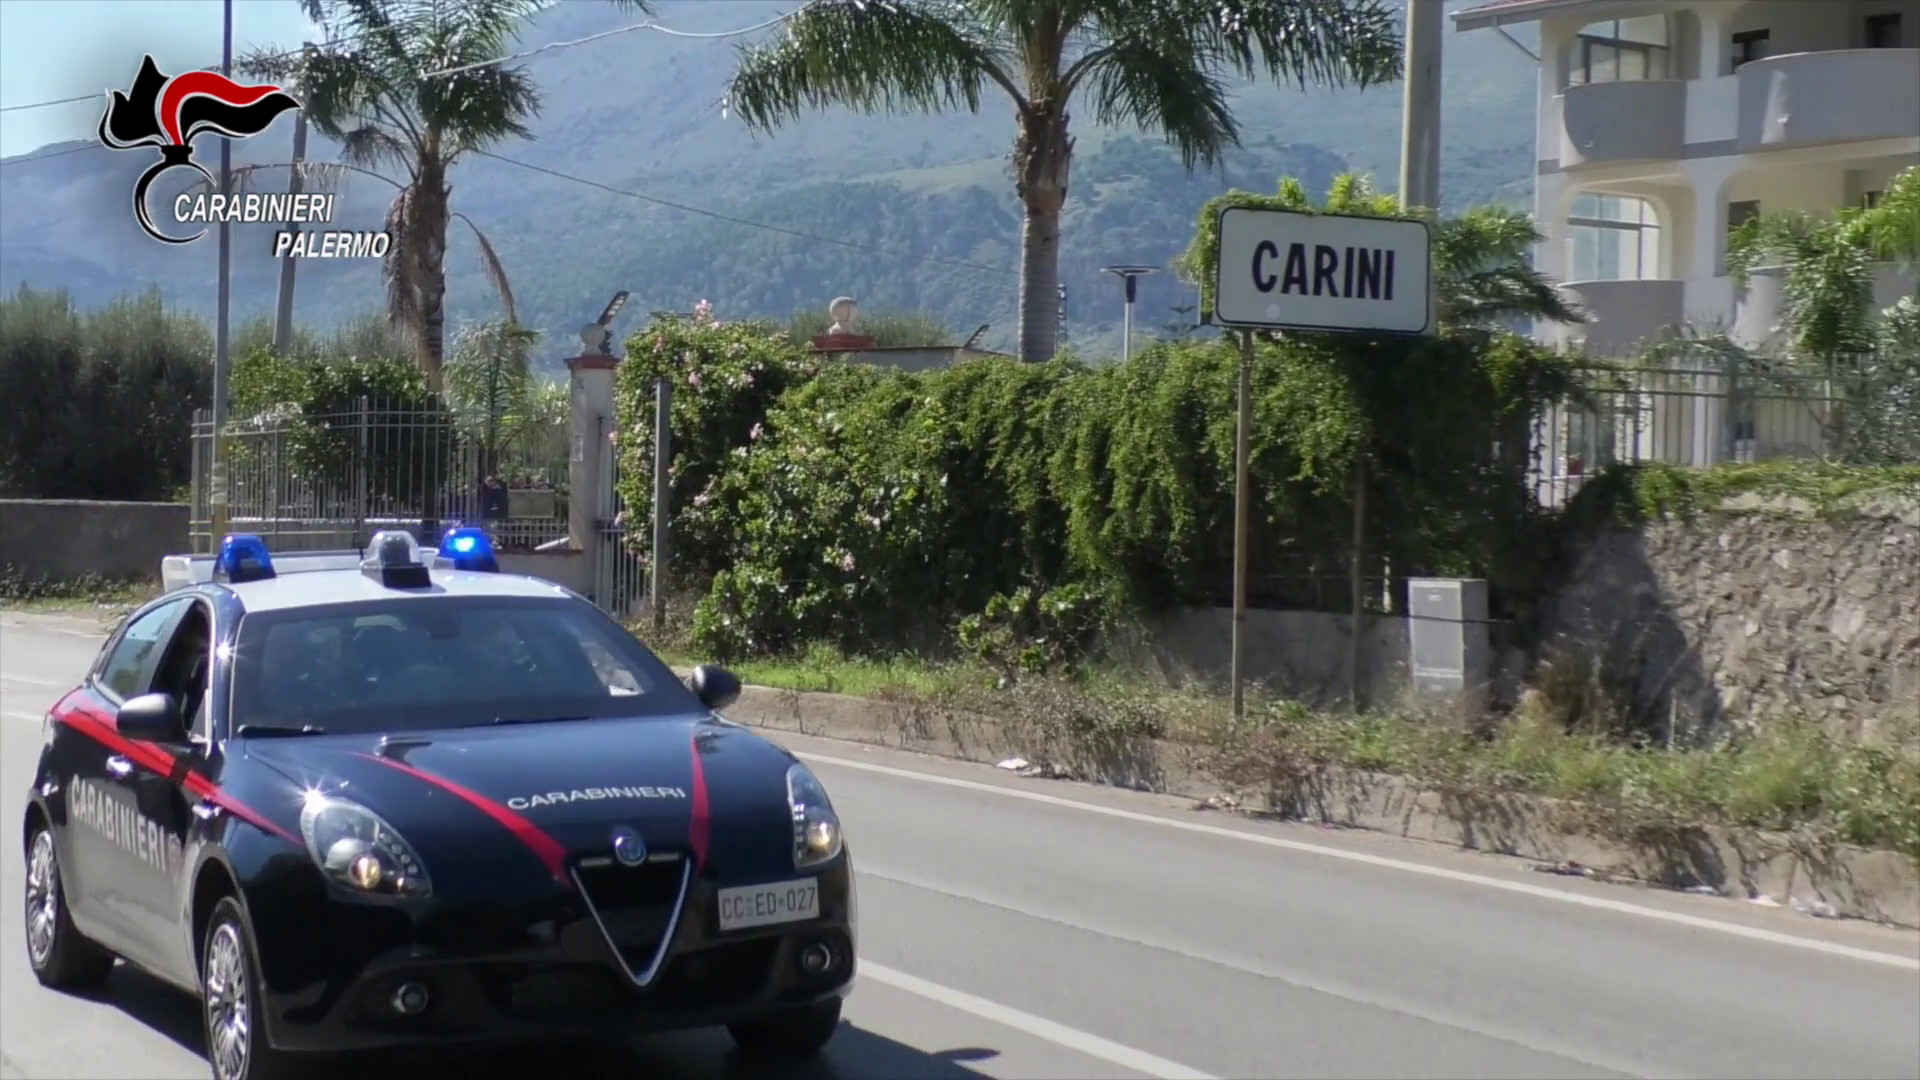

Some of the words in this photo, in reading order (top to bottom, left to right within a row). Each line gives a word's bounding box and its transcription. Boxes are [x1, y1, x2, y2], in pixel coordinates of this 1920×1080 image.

[1252, 239, 1396, 301] CARINI
[71, 773, 166, 872] CARABINIERI
[507, 786, 687, 810] CARABINIERI
